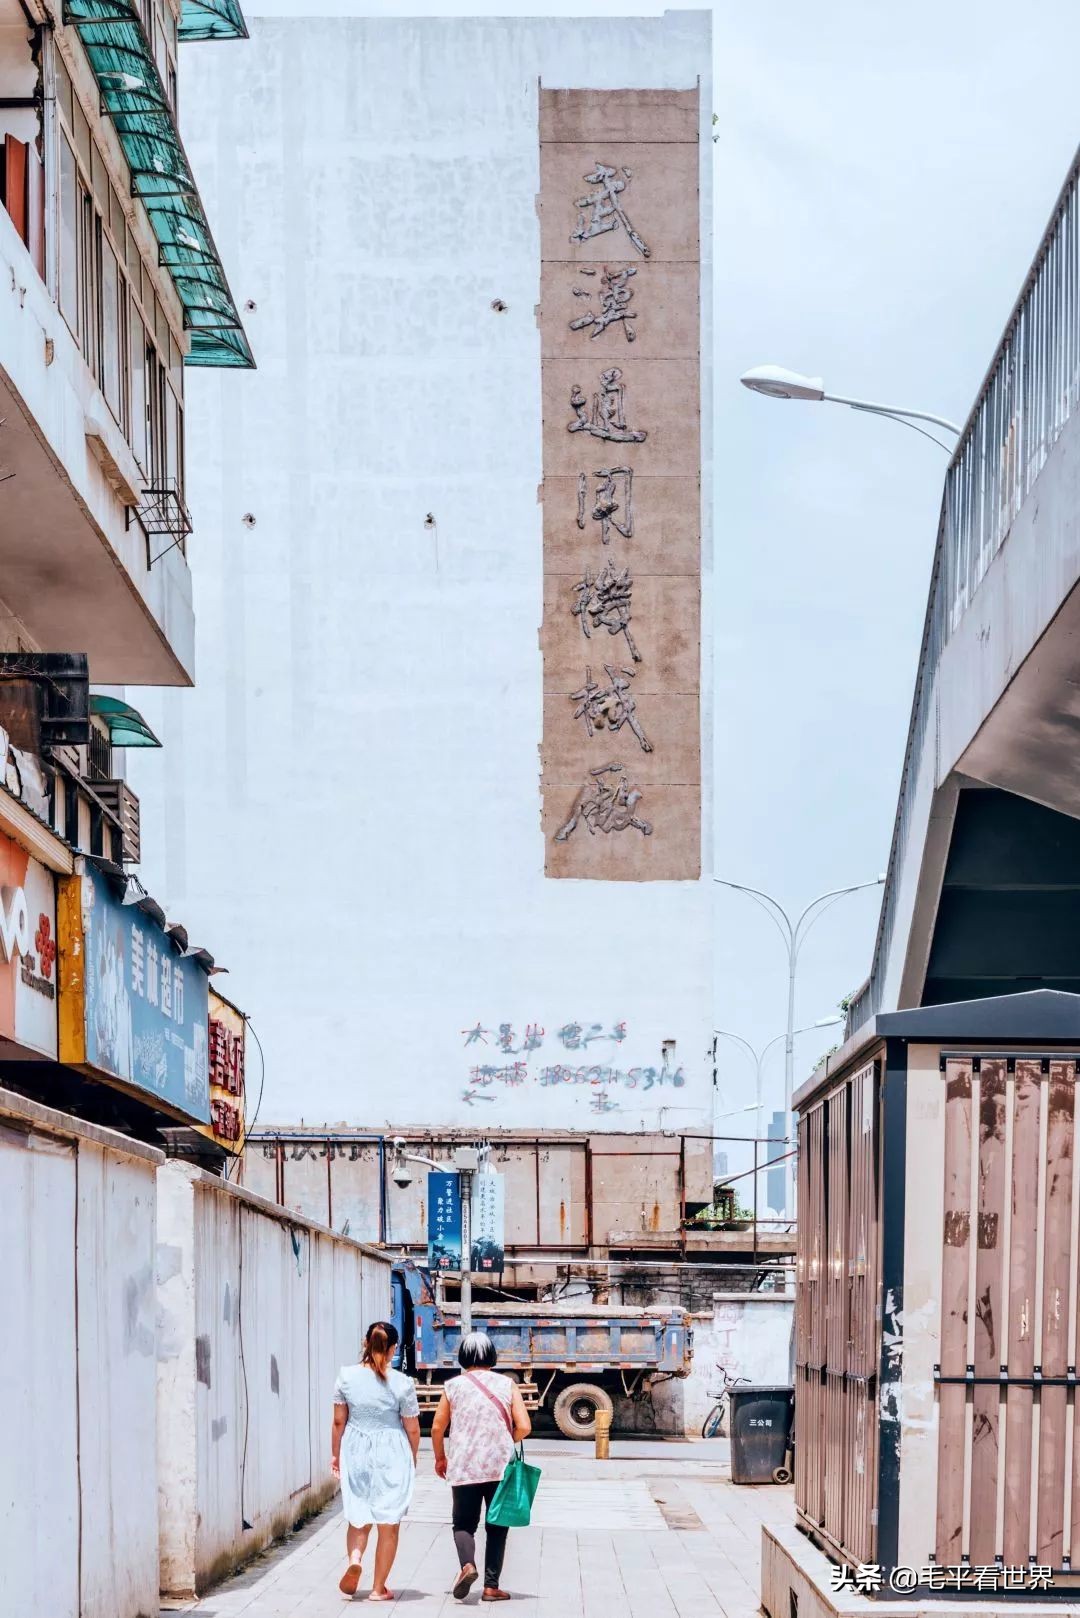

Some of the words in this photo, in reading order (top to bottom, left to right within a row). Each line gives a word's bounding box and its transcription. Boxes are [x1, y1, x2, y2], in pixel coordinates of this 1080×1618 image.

[131, 923, 185, 1025] 美林超市
[445, 1180, 454, 1223] 万警进社区
[749, 1419, 772, 1427] 三公司
